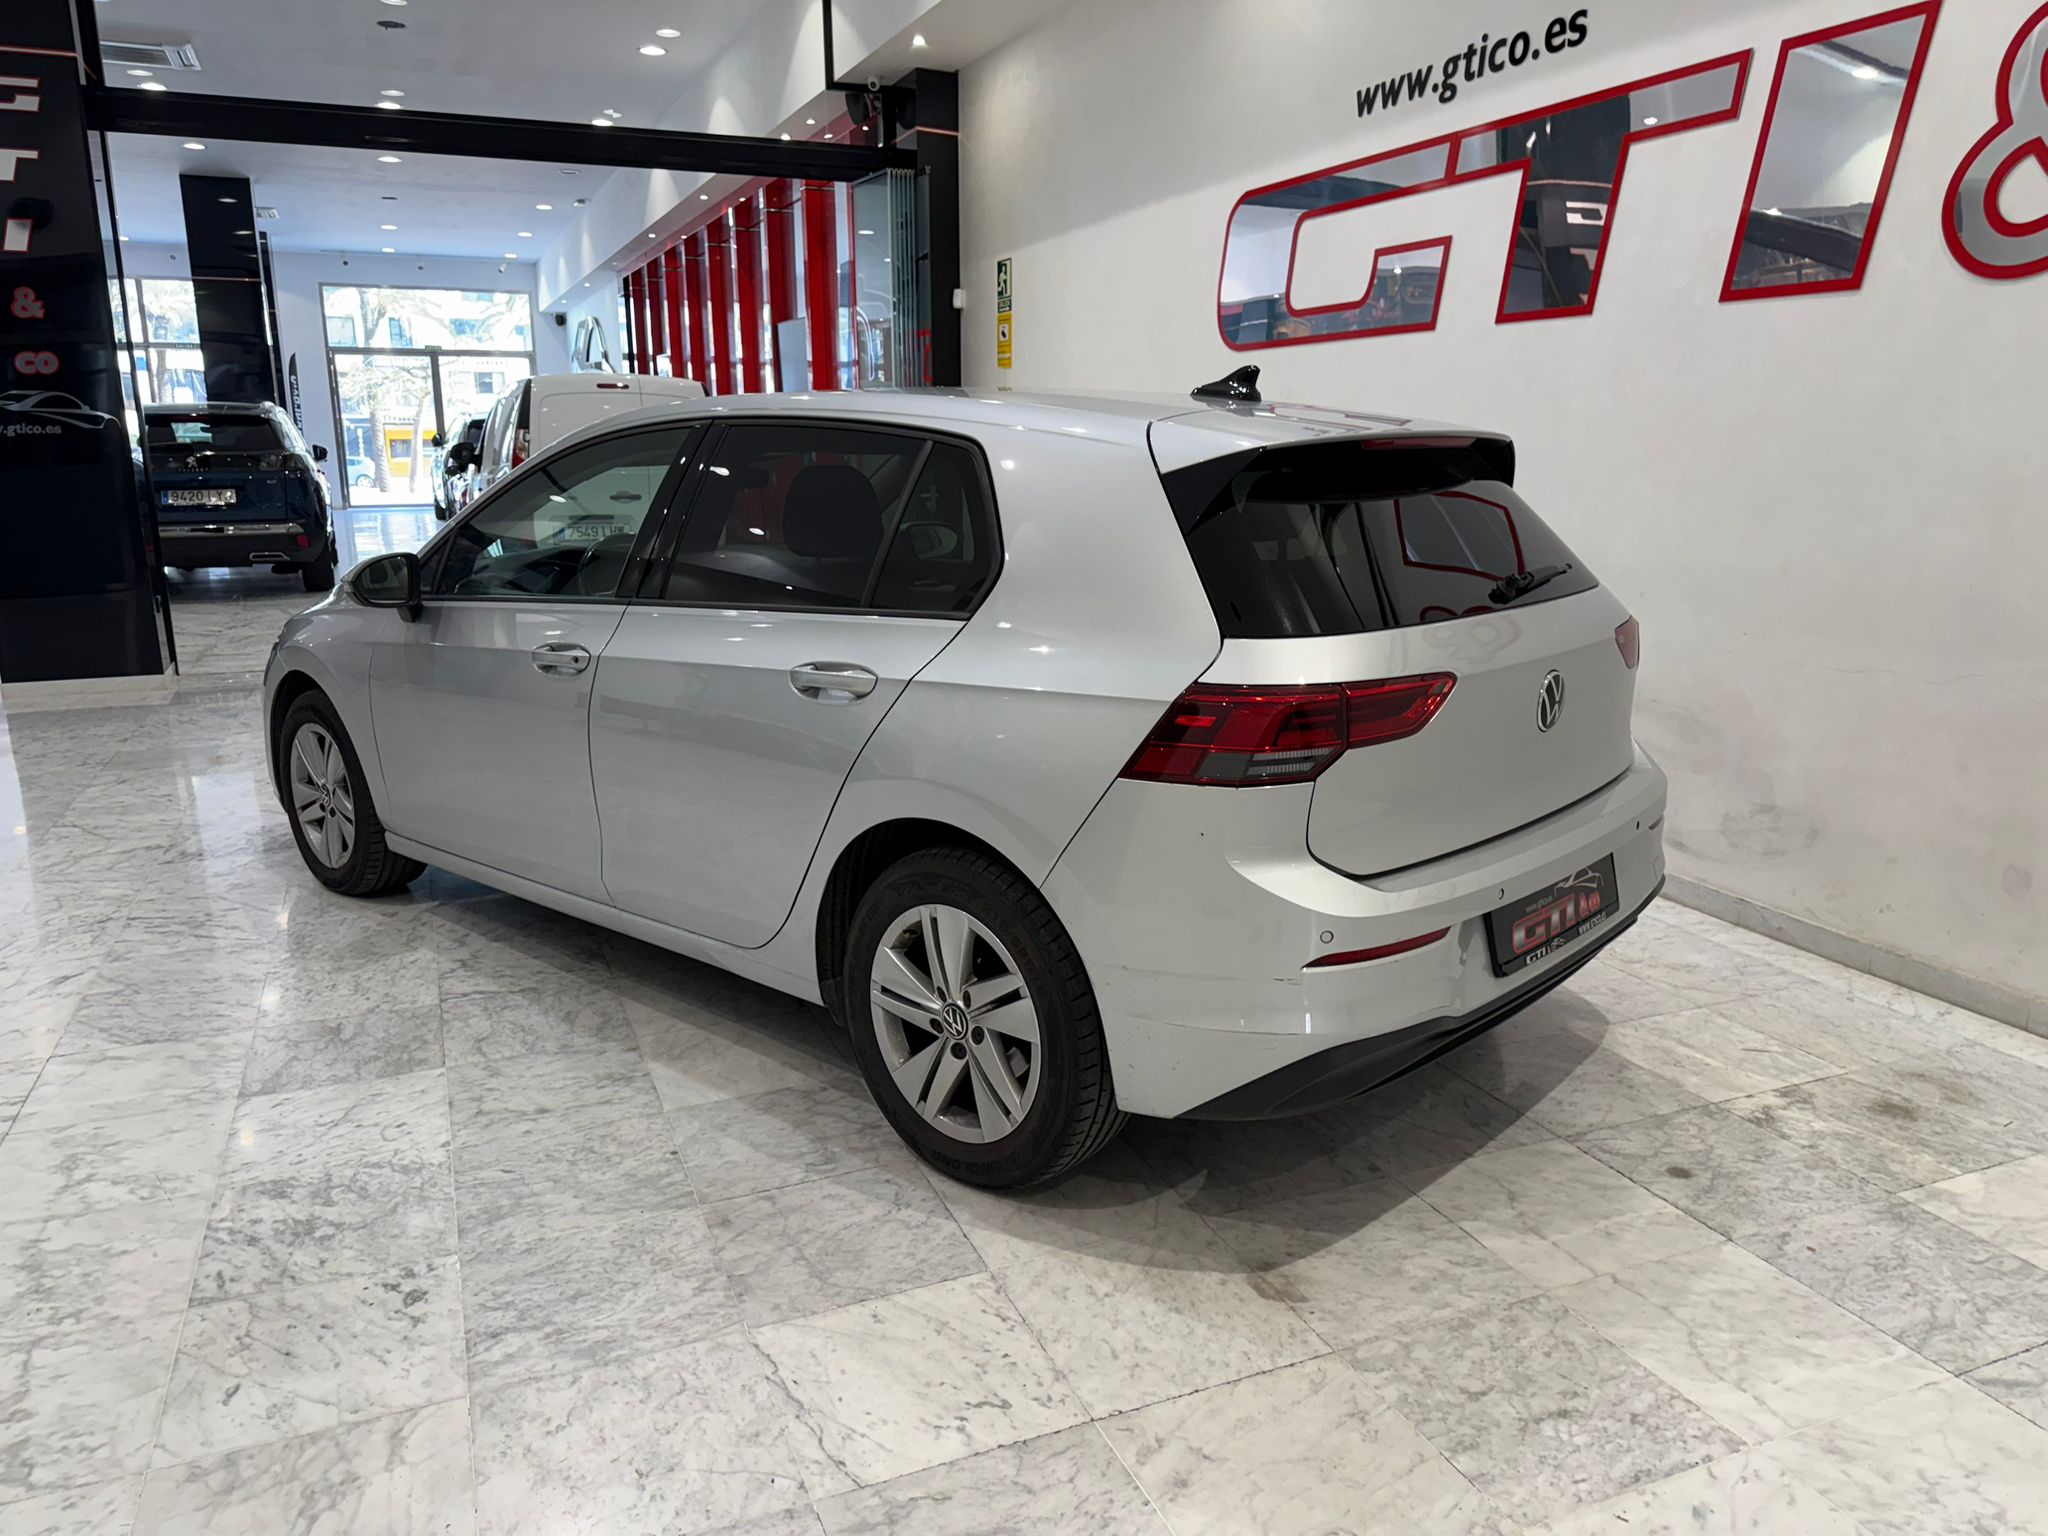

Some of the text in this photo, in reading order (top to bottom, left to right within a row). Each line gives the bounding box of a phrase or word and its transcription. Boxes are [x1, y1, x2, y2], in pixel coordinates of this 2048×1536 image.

[1356, 9, 1589, 118] www.gtico.es
[1218, 0, 1941, 352] GTI
[11, 286, 46, 319] &
[0, 422, 62, 437] .gtico.es
[171, 490, 204, 502] 9420
[568, 525, 599, 538] 7549
[1512, 893, 1577, 955] GTI
